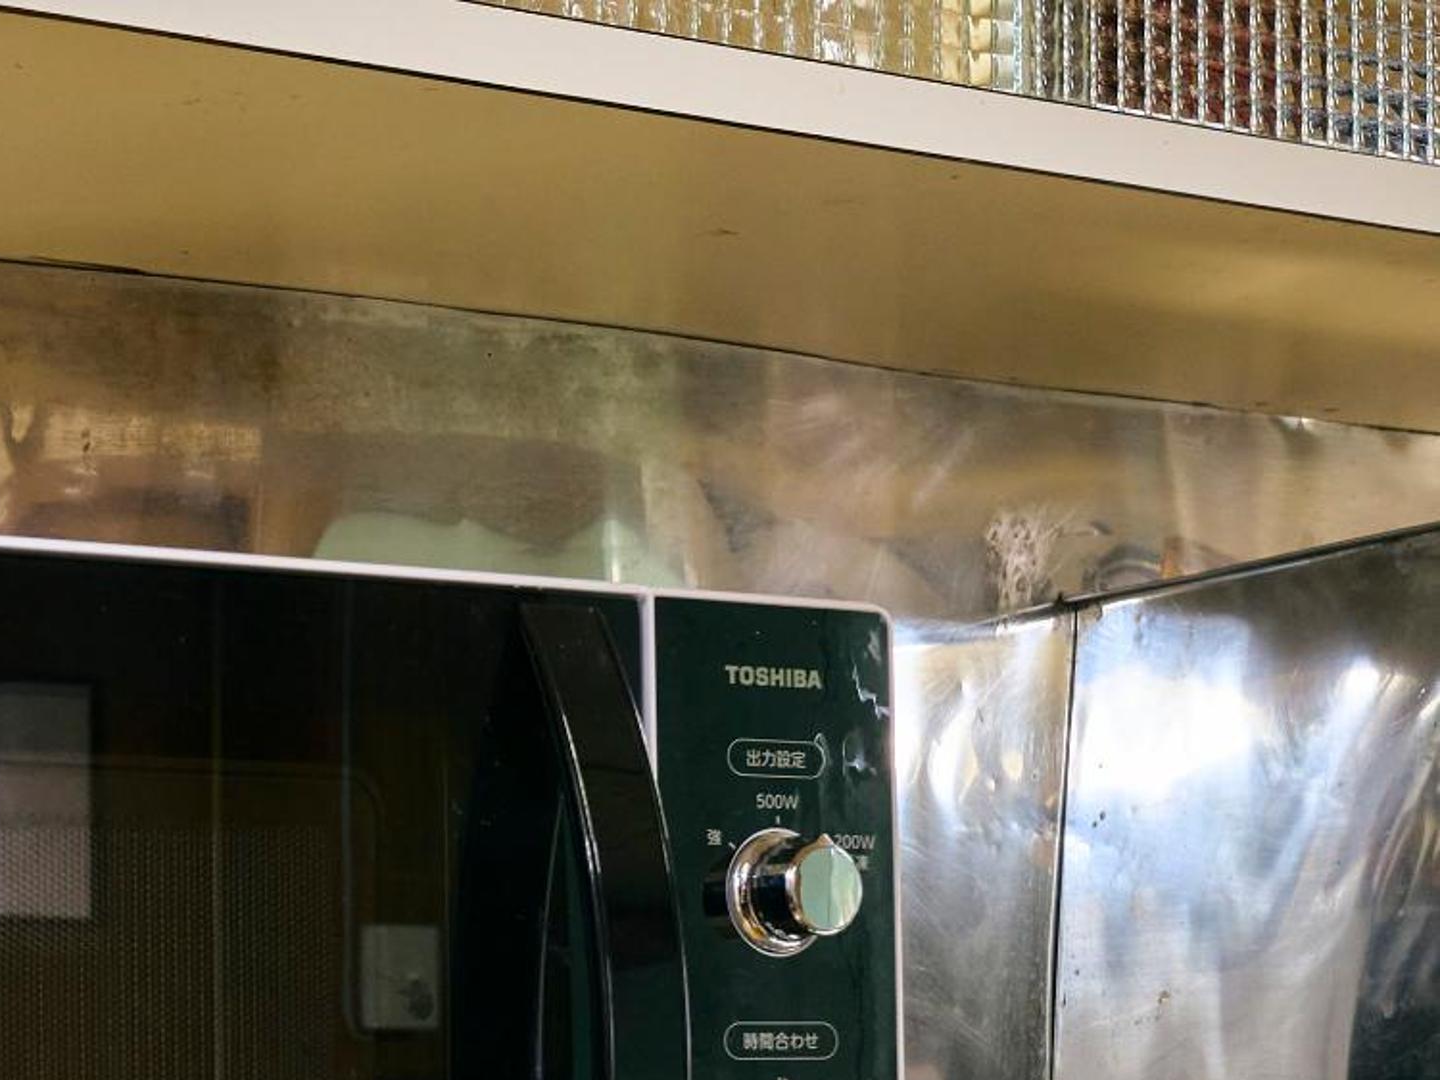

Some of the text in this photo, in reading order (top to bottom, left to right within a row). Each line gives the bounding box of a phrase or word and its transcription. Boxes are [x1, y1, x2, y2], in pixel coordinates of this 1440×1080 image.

[725, 665, 823, 689] TOSHIBA
[746, 749, 807, 769] 出力設定
[756, 793, 800, 810] 500W
[707, 829, 723, 846] 強
[833, 834, 877, 850] 200W
[741, 1031, 820, 1051] 時間合わせ
